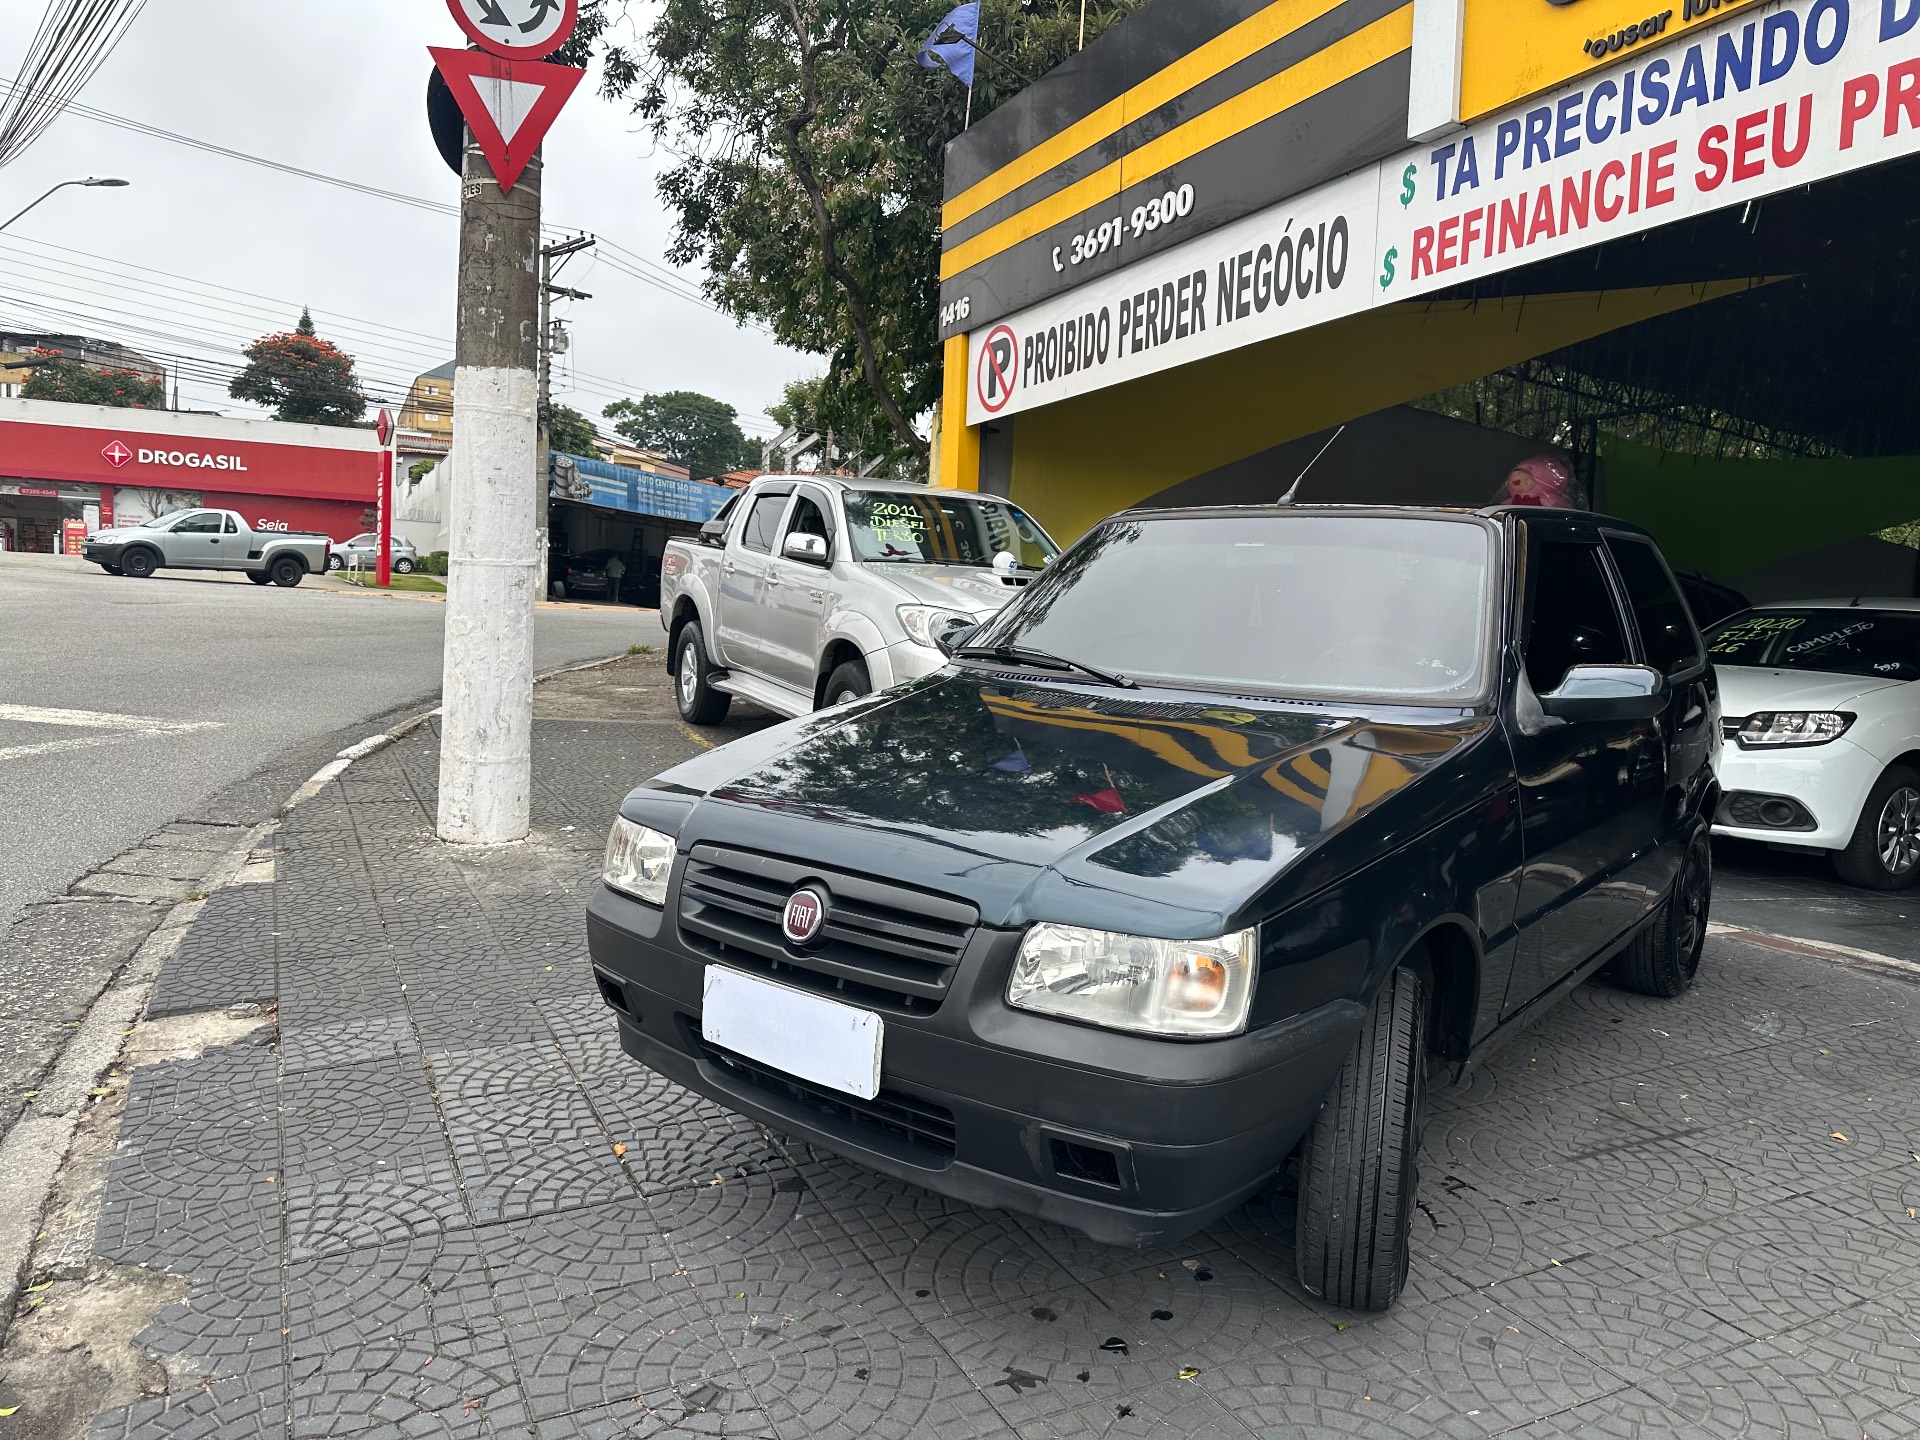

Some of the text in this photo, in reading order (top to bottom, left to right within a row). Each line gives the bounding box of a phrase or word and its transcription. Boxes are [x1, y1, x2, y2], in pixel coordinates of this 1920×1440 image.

[1431, 136, 1479, 201] TA
[1494, 0, 1849, 180] PRECISANDO
[1411, 140, 1677, 281] REFINANCIE
[1695, 93, 1813, 192] SEU
[1071, 183, 1195, 265] 3691-9300
[940, 296, 970, 327] 1416
[1023, 215, 1349, 388] PROIBIDO PERDER NEGÓCIO
[138, 448, 248, 471] DROGASIL
[655, 478, 676, 489] CENTER
[872, 502, 924, 519] 2011
[1786, 621, 1875, 653] COMPLETO
[790, 904, 814, 929] FIAT
